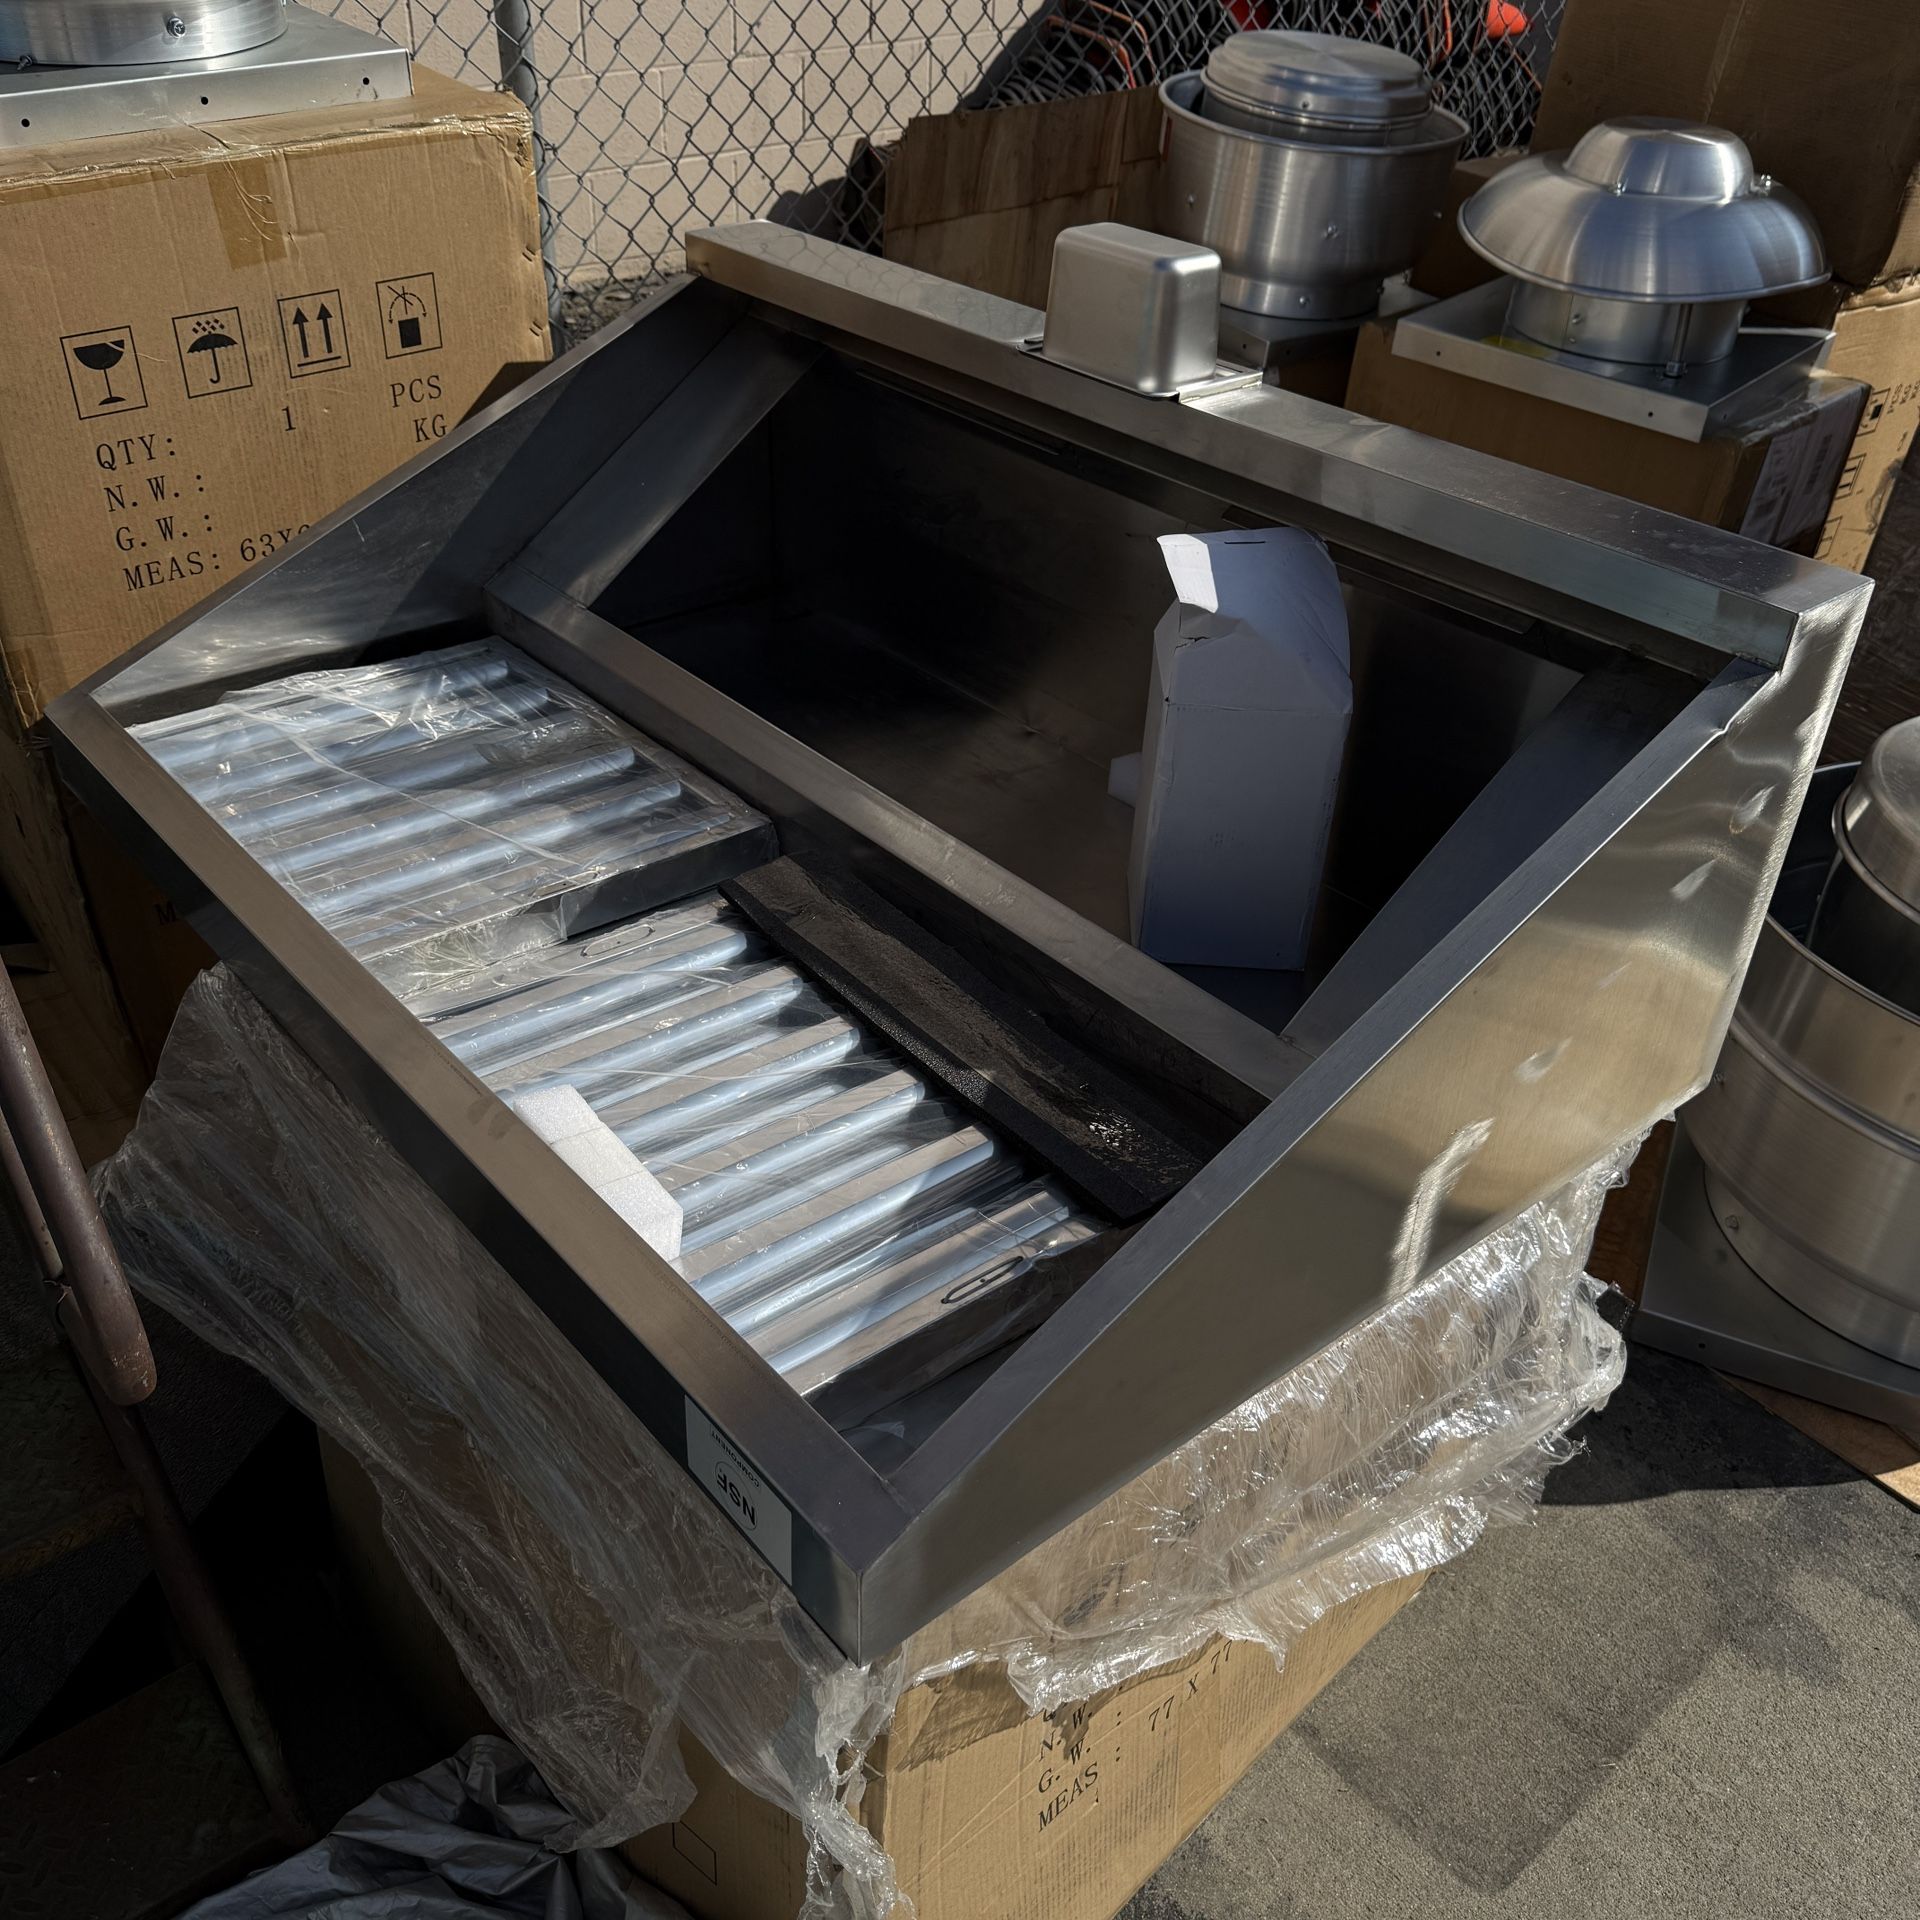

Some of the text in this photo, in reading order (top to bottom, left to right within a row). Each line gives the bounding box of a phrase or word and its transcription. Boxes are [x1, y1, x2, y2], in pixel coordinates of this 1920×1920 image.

[96, 375, 442, 471] QTY: 1 PCS
[413, 414, 448, 443] KG
[123, 551, 220, 592] MEAS:
[711, 1430, 760, 1488] COMPONENT
[716, 1472, 756, 1526] NSF
[1148, 1695, 1174, 1732] 77
[1210, 1640, 1232, 1675] 77
